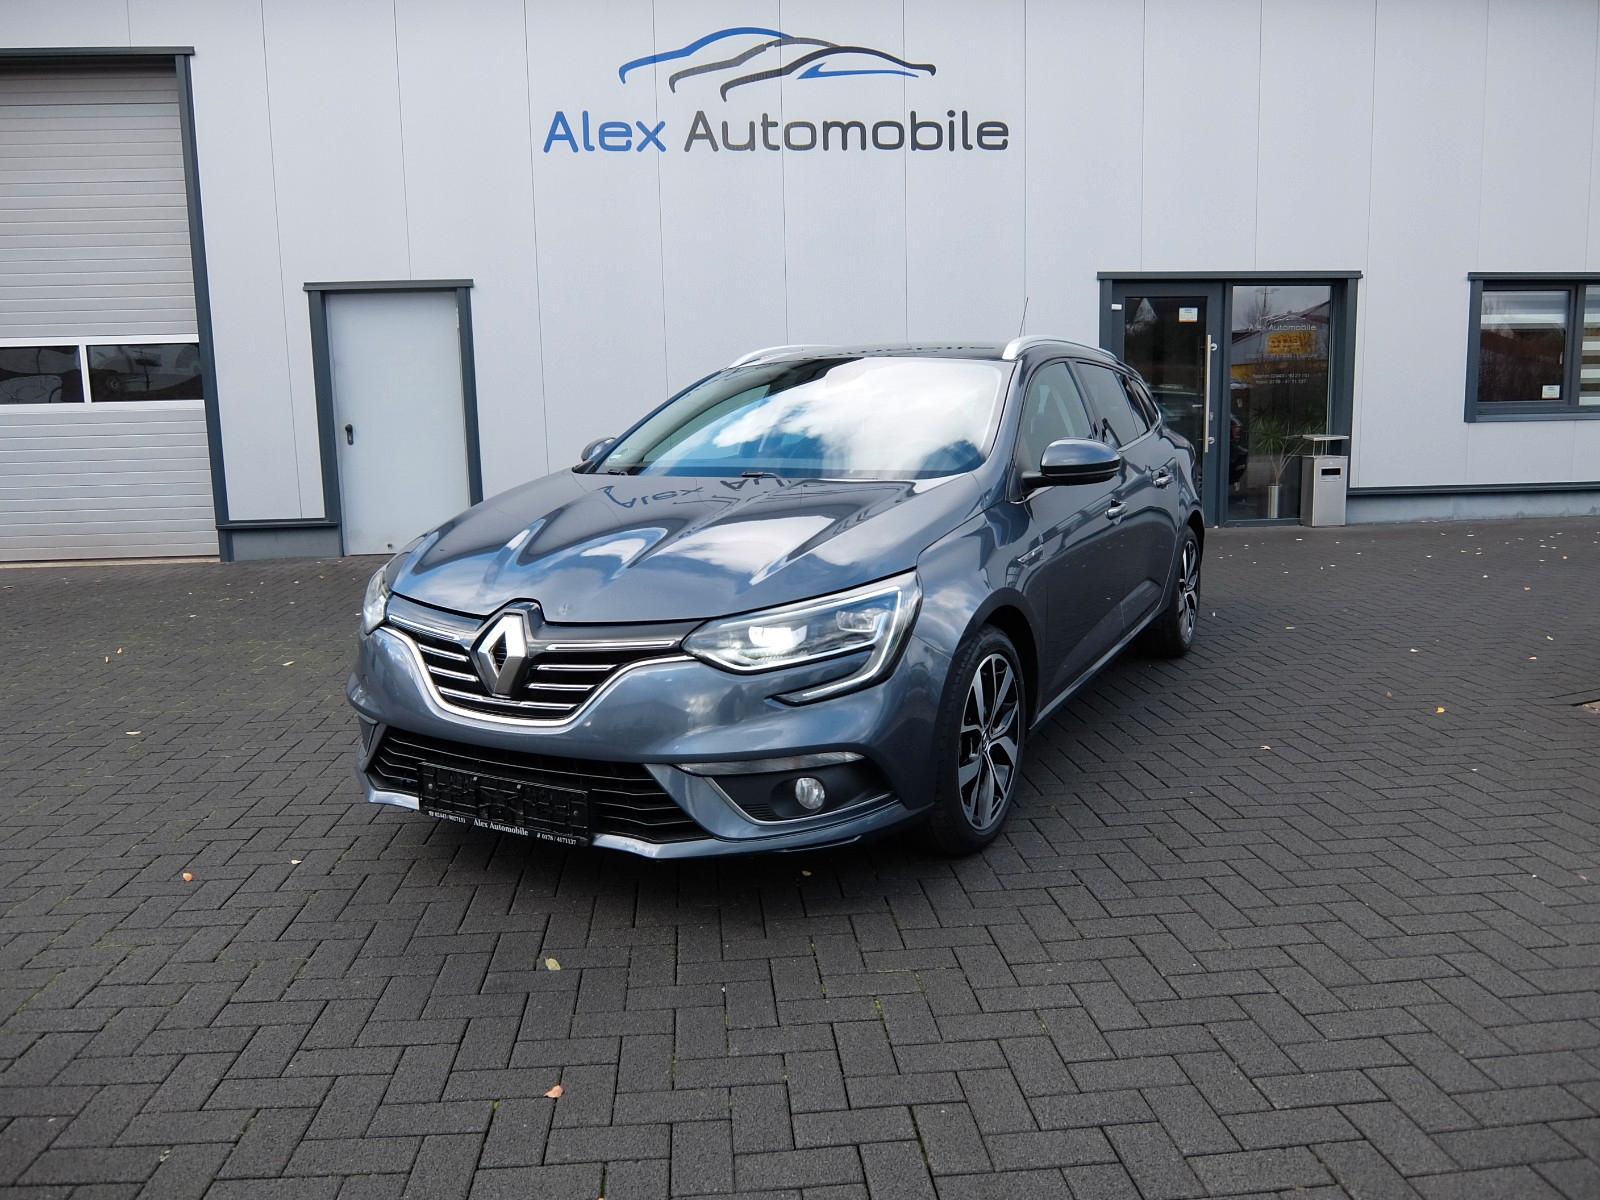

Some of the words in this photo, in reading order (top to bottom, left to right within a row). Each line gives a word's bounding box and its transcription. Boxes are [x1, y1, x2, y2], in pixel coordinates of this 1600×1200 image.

[543, 110, 666, 152] Alex
[684, 109, 1009, 152] Automobile
[1269, 322, 1318, 331] Automobile
[473, 818, 489, 829] Alex
[489, 821, 529, 837] Automobile
